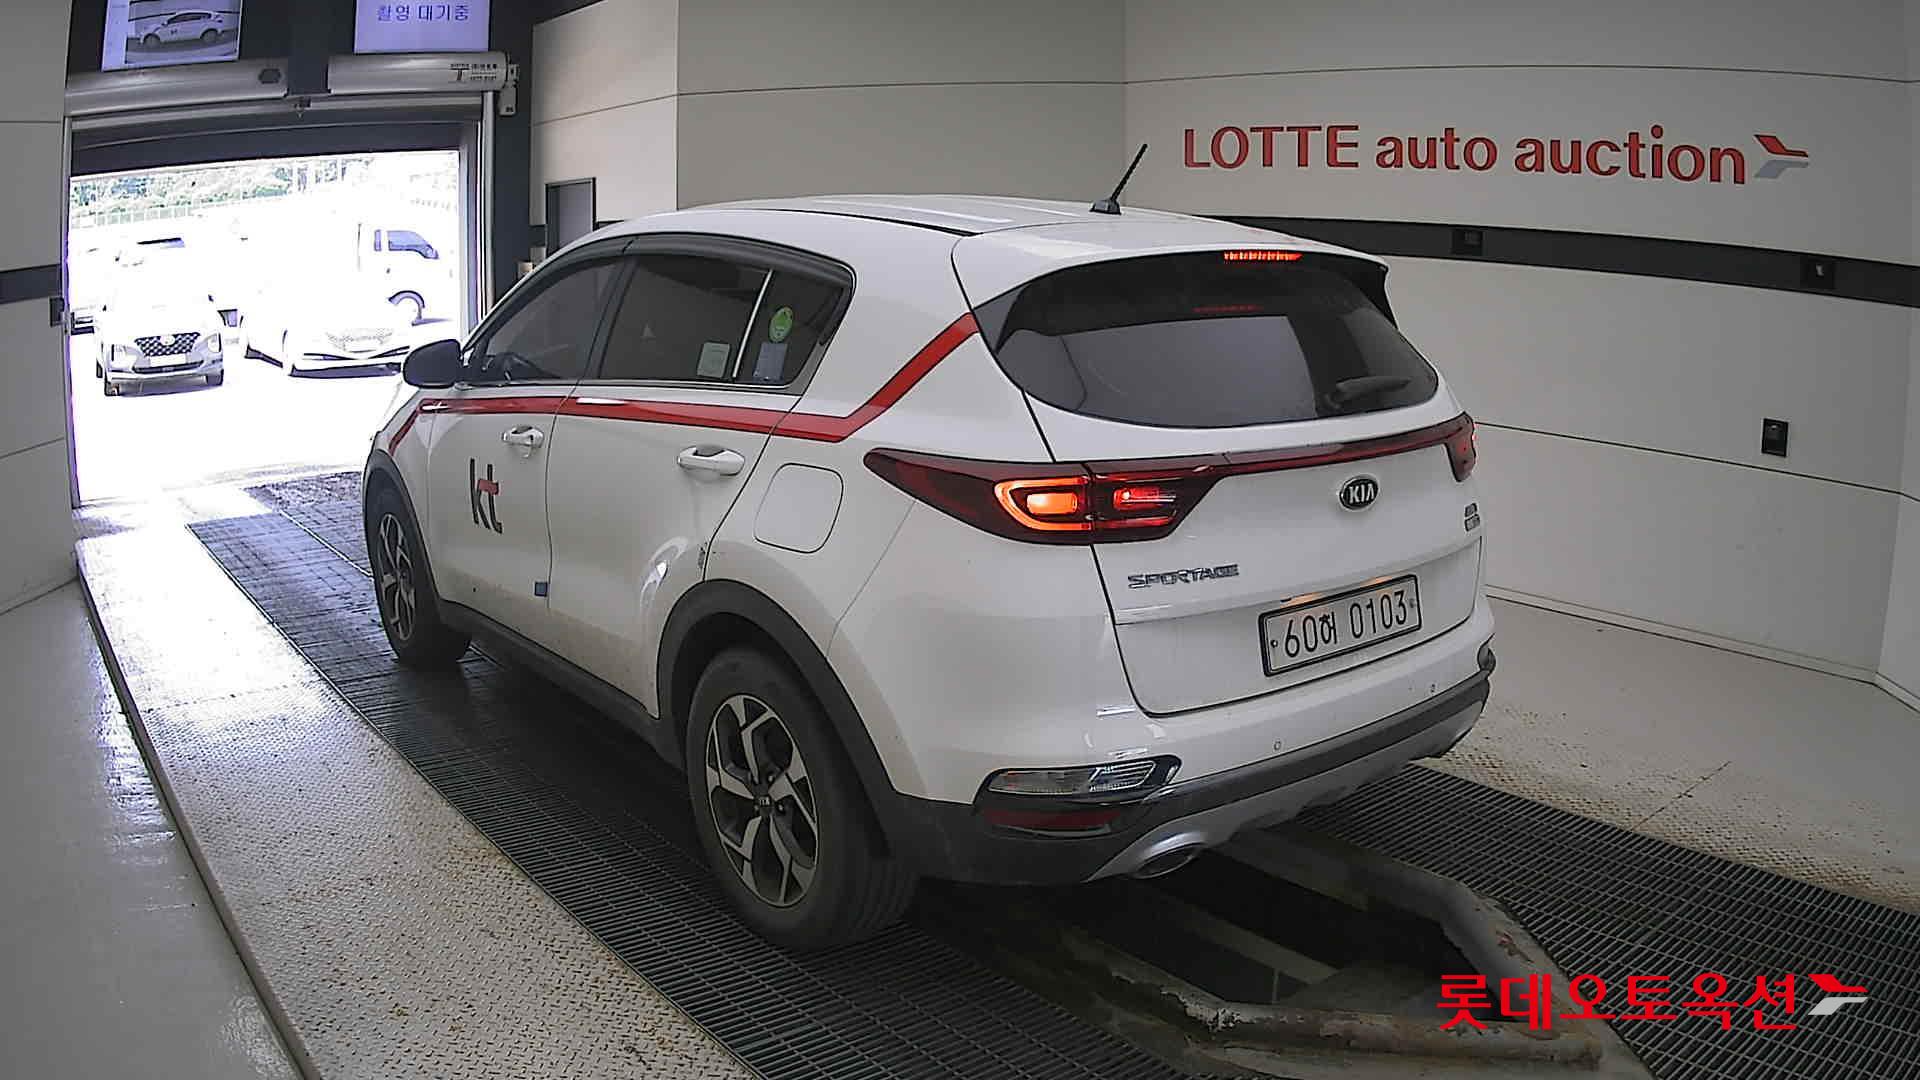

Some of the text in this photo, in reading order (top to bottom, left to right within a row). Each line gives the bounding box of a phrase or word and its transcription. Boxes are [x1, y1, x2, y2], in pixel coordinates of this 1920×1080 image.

[418, 4, 469, 21] 대기중
[1184, 124, 1746, 185] LOTTE auto auction
[469, 457, 503, 535] kt
[1348, 483, 1375, 504] KIA
[1127, 563, 1240, 589] SPORTAGE
[1284, 589, 1408, 658] 60허 0103
